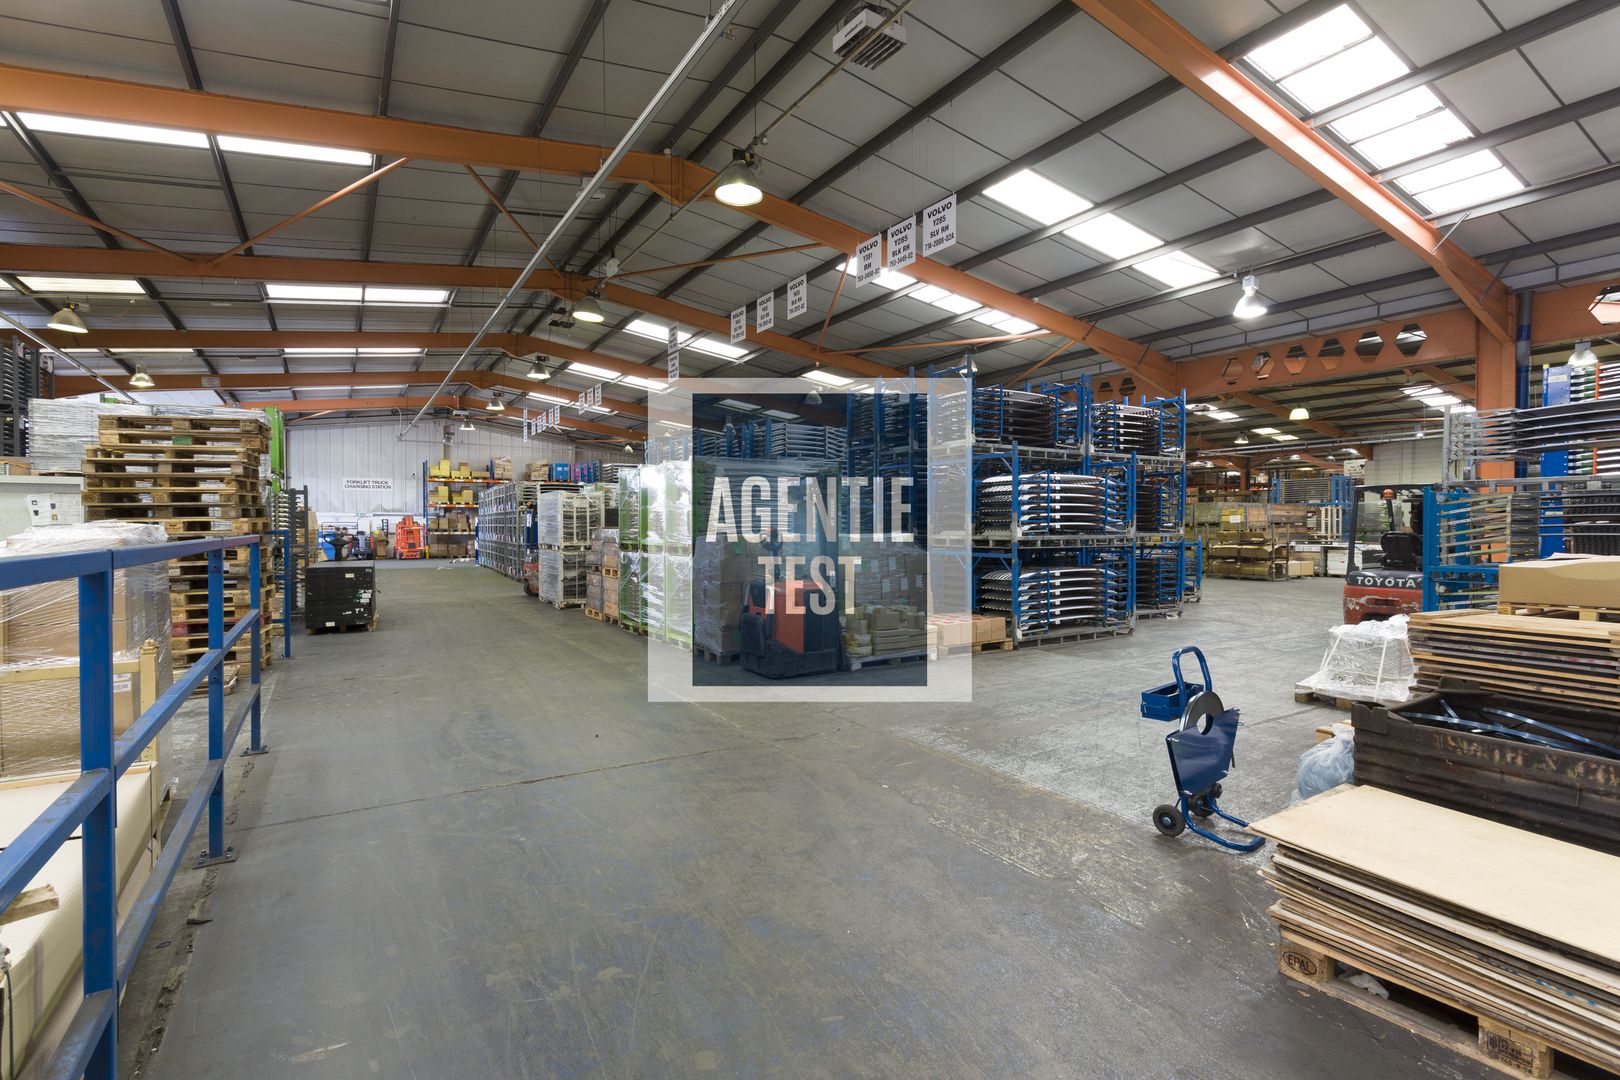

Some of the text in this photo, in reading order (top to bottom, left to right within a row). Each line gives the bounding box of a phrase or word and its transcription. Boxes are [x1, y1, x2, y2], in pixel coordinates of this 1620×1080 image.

[928, 201, 952, 219] VOLVO
[890, 222, 912, 239] VOLVO
[930, 224, 949, 239] SLV RH
[858, 240, 878, 255] VOLVO
[892, 243, 910, 258] BLK RH
[864, 262, 872, 271] RH
[790, 279, 804, 291] VOLVO
[758, 296, 772, 307] VOLVO
[732, 310, 744, 319] VOLVO
[1356, 577, 1416, 587] TOYOTA
[1287, 953, 1313, 973] EPAL
